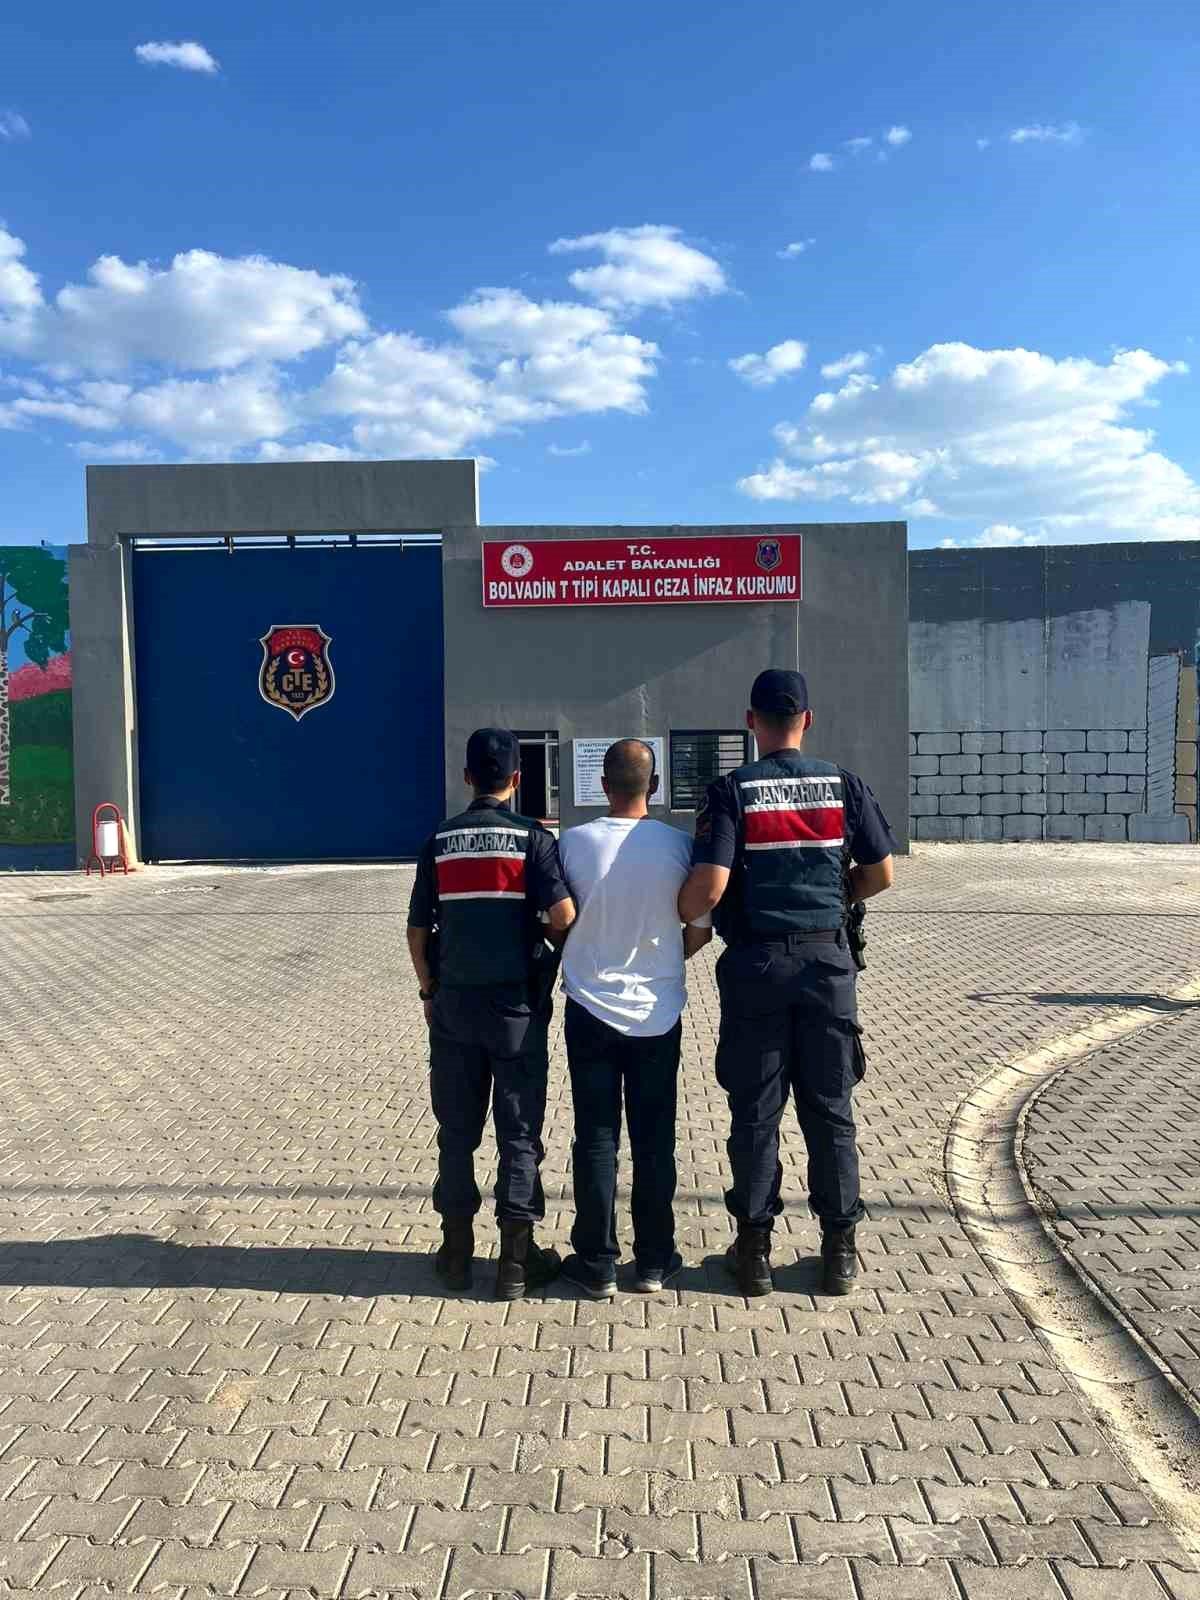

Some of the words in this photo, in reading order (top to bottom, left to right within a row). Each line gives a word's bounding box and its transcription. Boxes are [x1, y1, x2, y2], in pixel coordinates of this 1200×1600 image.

[626, 544, 656, 556] T.C.
[563, 560, 625, 571] ADALET
[631, 555, 721, 570] BAKANLIĞI
[488, 577, 555, 600] BOLVADİN
[559, 580, 567, 599] T
[572, 576, 599, 598] TİPİ
[602, 578, 650, 597] KAPALI
[654, 577, 690, 596] CEZA
[694, 573, 733, 595] İNFAZ
[736, 574, 797, 595] KURUMU
[282, 668, 312, 692] CTE
[754, 783, 835, 805] JANDARMA
[442, 834, 518, 854] JANDARMA
